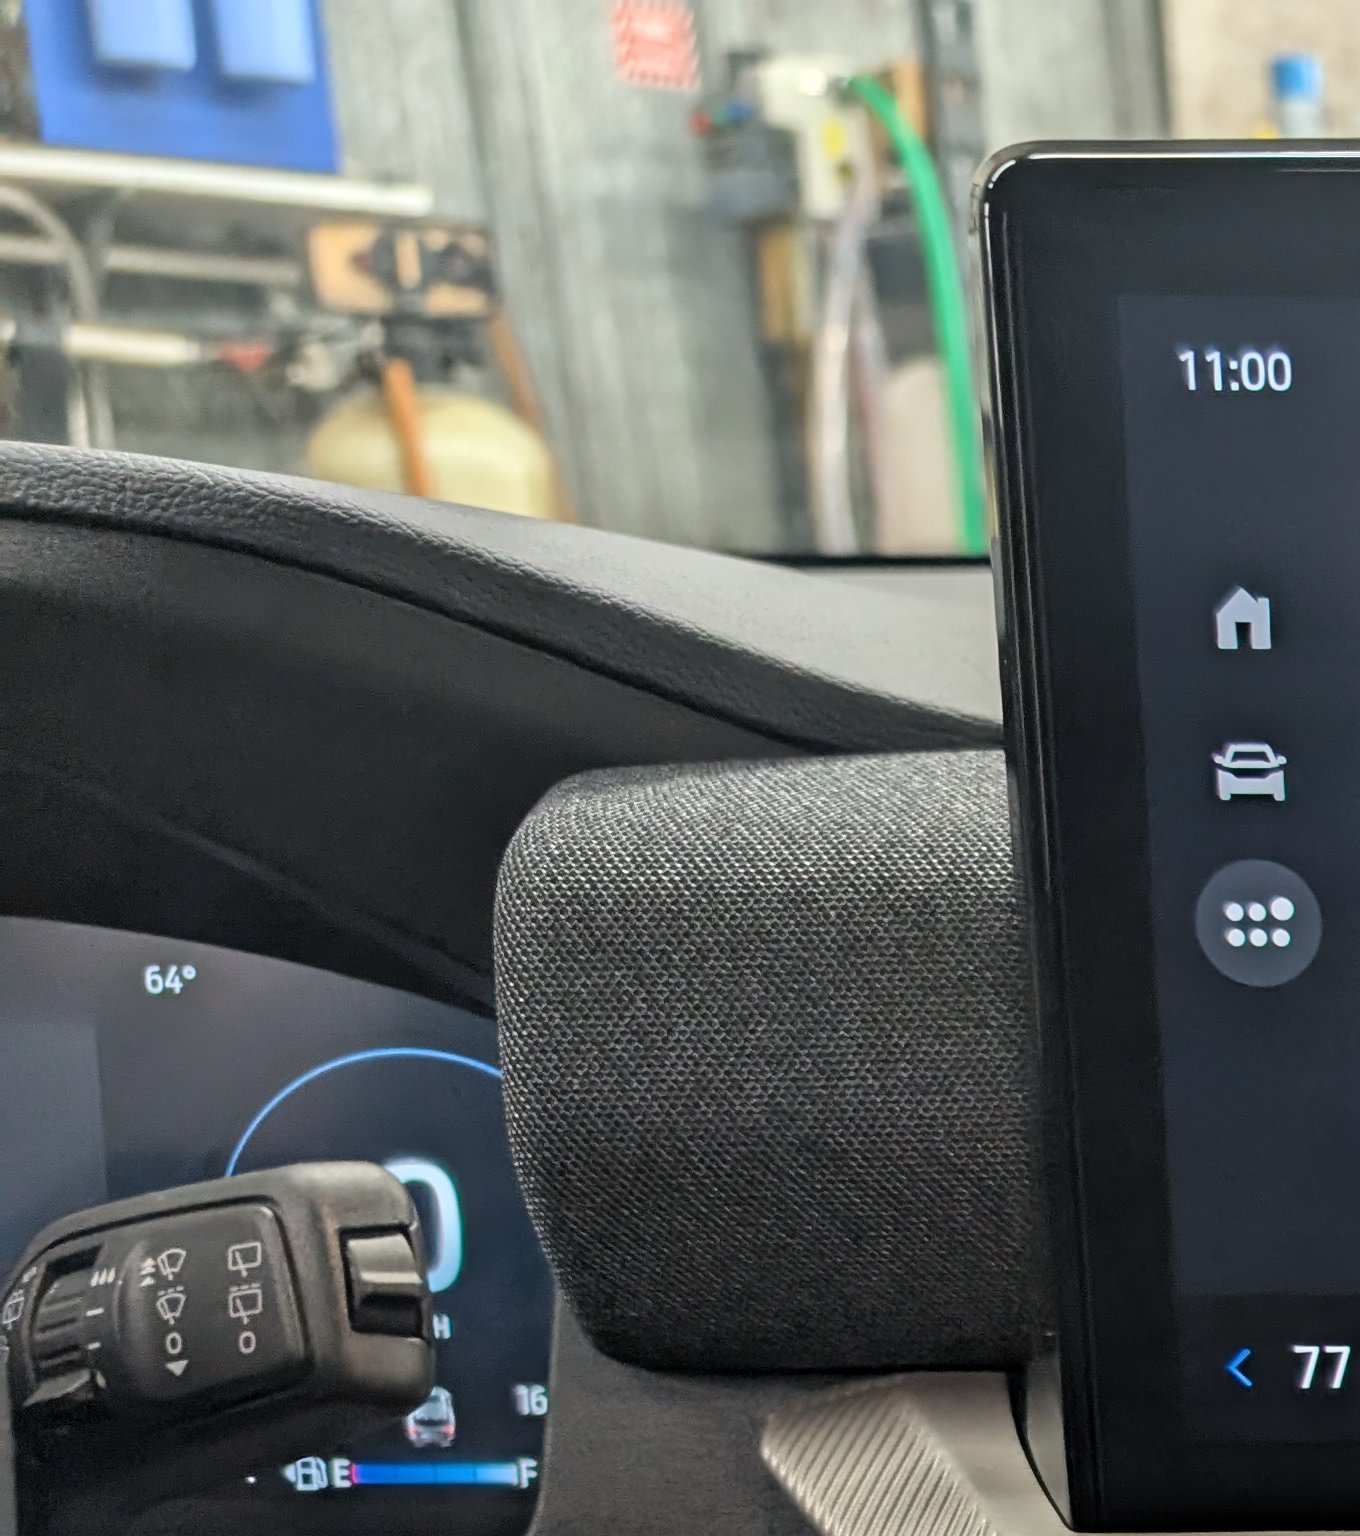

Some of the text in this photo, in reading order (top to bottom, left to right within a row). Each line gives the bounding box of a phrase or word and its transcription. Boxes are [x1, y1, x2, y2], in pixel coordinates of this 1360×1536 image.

[1178, 348, 1292, 392] 11:00
[1292, 1344, 1351, 1390] 77
[330, 1457, 352, 1489] E
[518, 1457, 538, 1489] F
